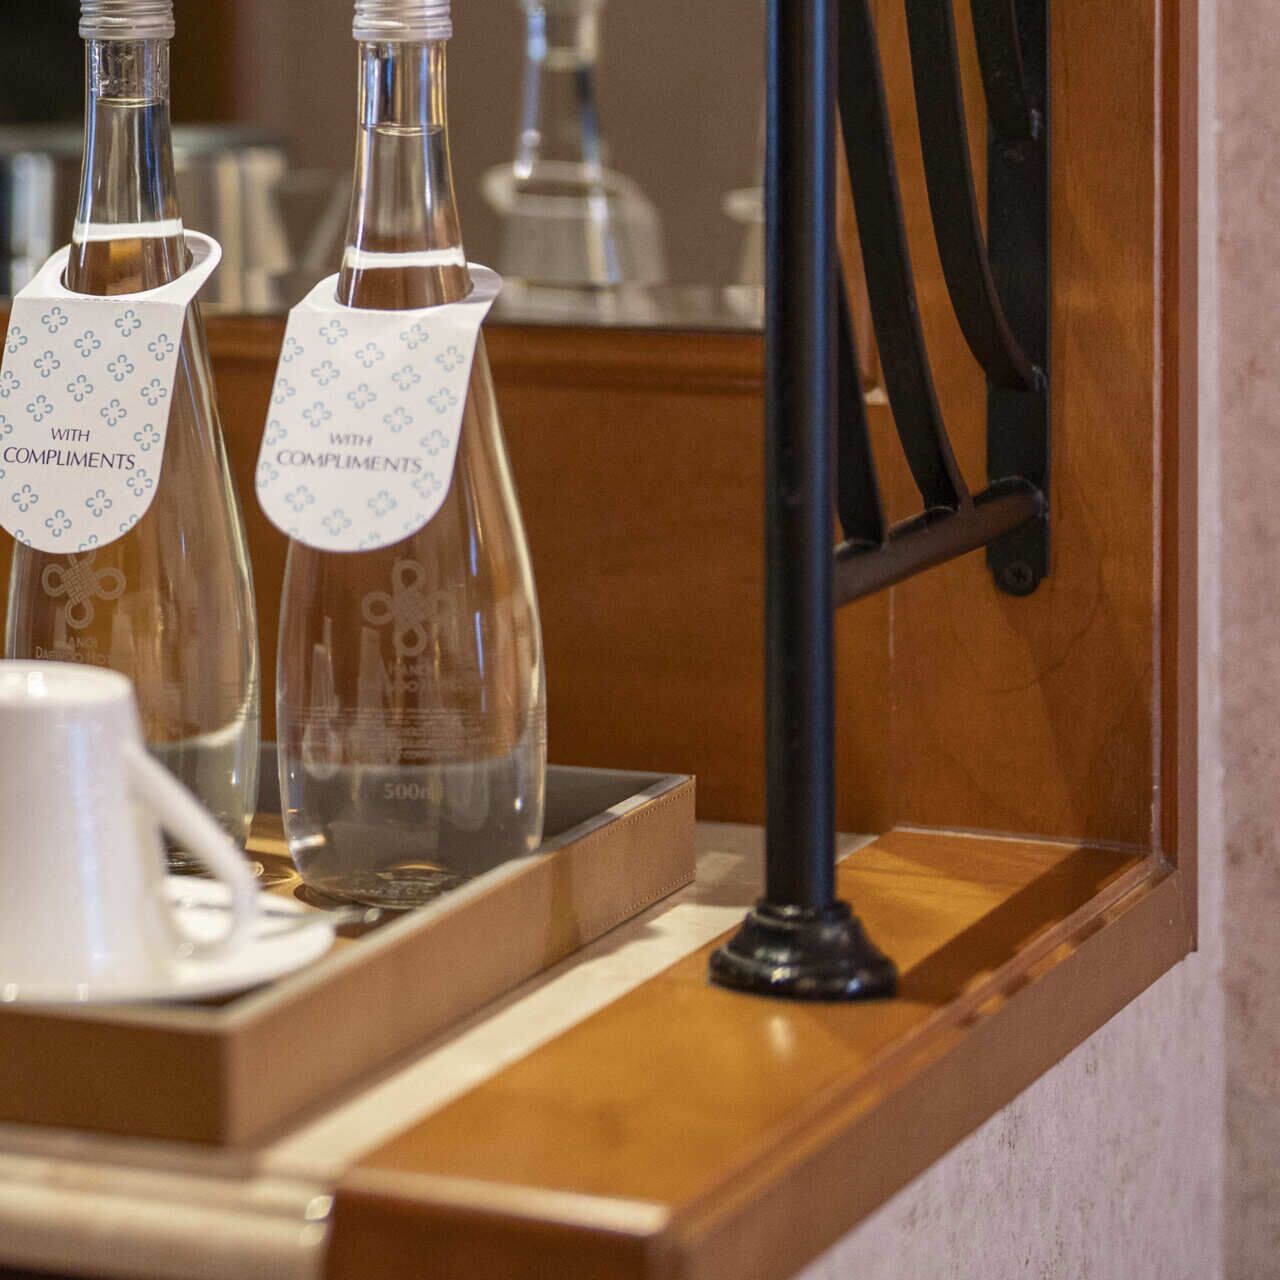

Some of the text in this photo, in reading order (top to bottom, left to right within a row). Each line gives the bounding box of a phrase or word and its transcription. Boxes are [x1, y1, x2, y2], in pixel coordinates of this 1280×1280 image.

[51, 426, 90, 442] WITH
[329, 432, 373, 447] WITH
[3, 446, 136, 470] COMPLIMENTS
[276, 449, 423, 474] COMPLIMENTS
